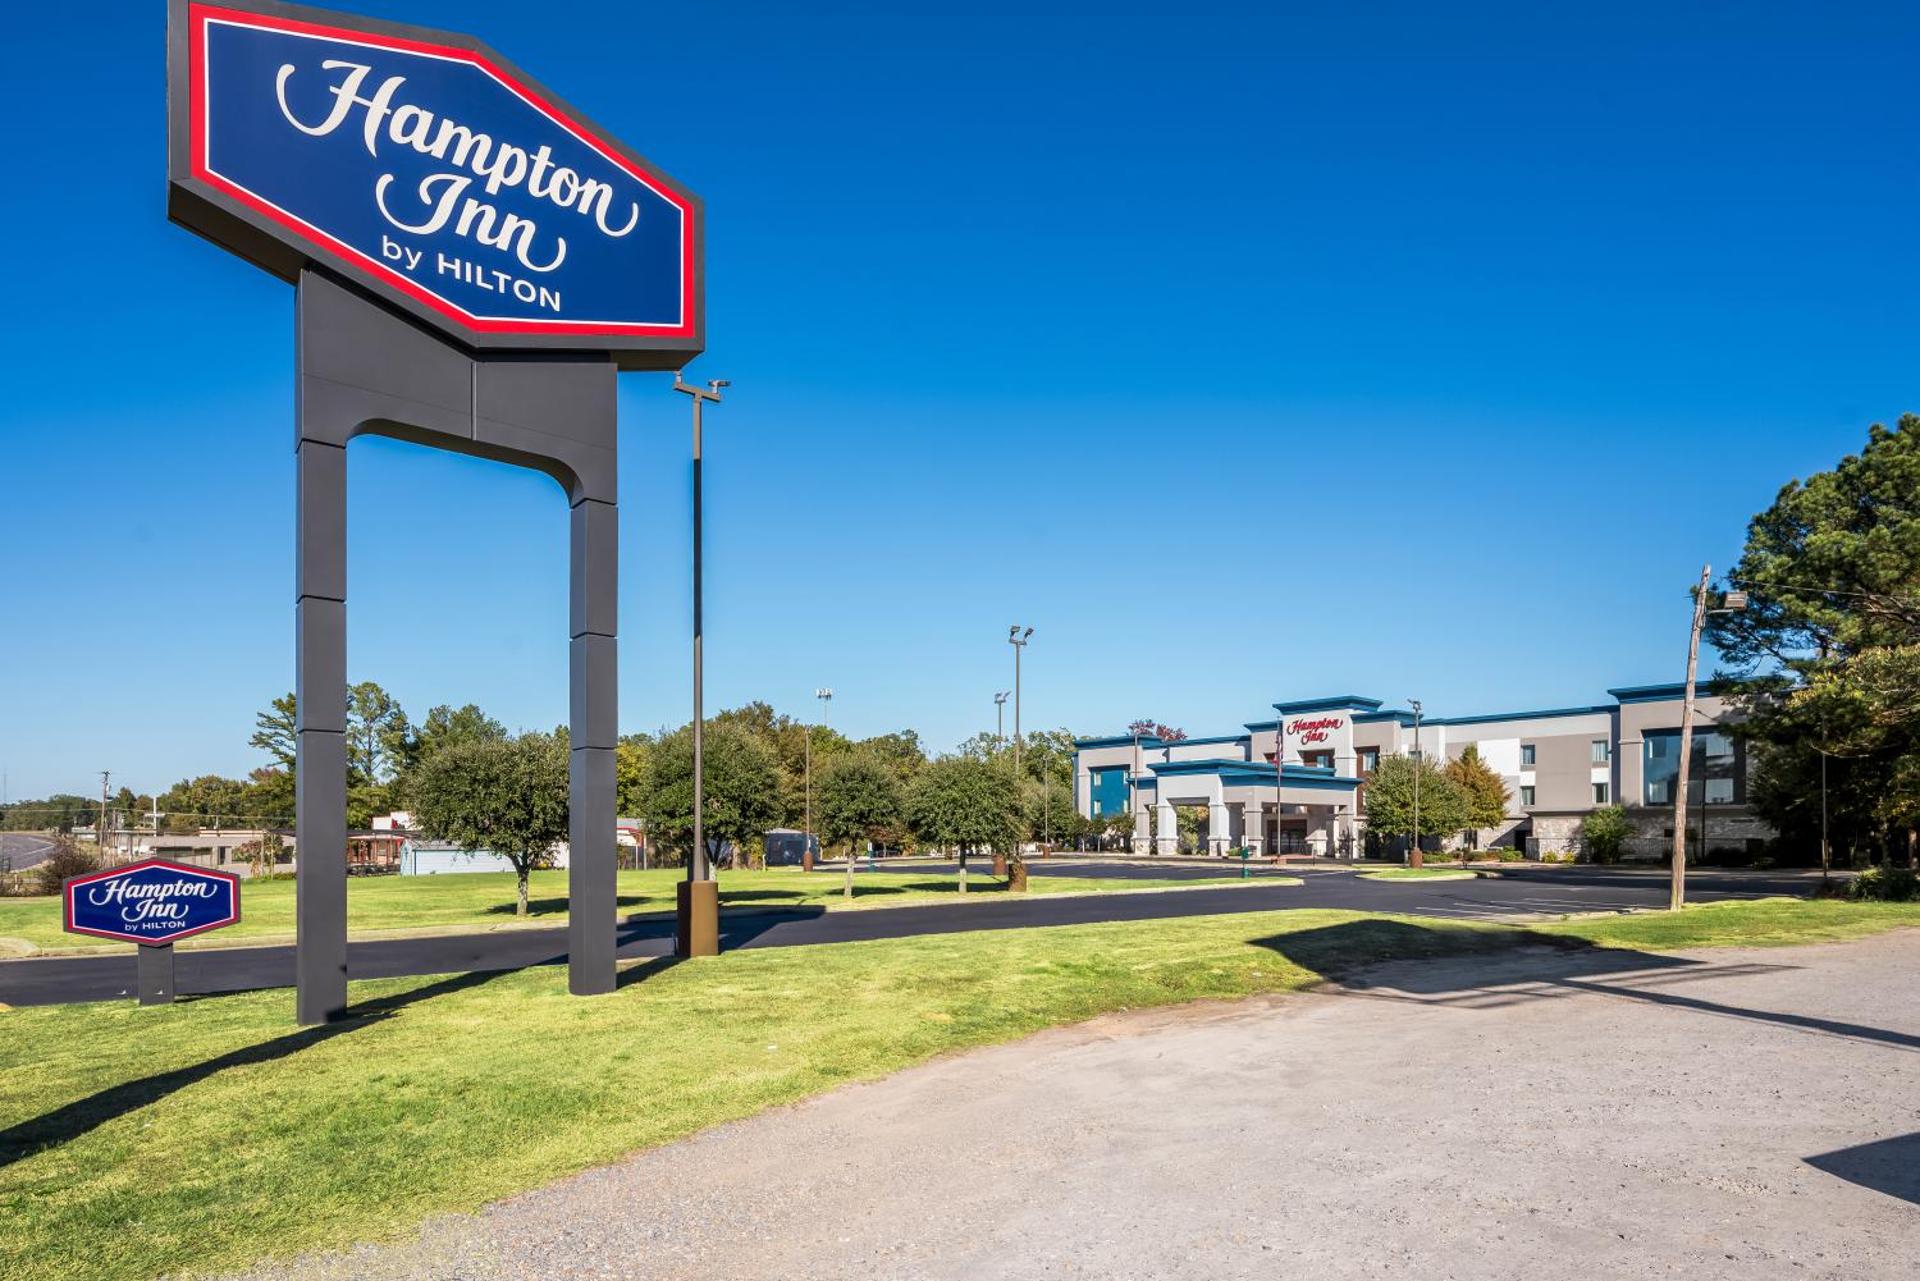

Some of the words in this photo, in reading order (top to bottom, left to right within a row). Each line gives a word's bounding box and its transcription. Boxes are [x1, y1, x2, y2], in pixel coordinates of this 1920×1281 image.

[276, 59, 639, 237] Hampton
[376, 173, 566, 272] Inn
[382, 235, 423, 271] by
[438, 252, 561, 312] HILTON
[1287, 718, 1343, 735] Hampton
[1301, 730, 1328, 745] Inn
[89, 877, 218, 906] Hampton
[121, 898, 189, 922] Inn
[124, 922, 138, 932] by
[142, 920, 186, 930] HILTON
